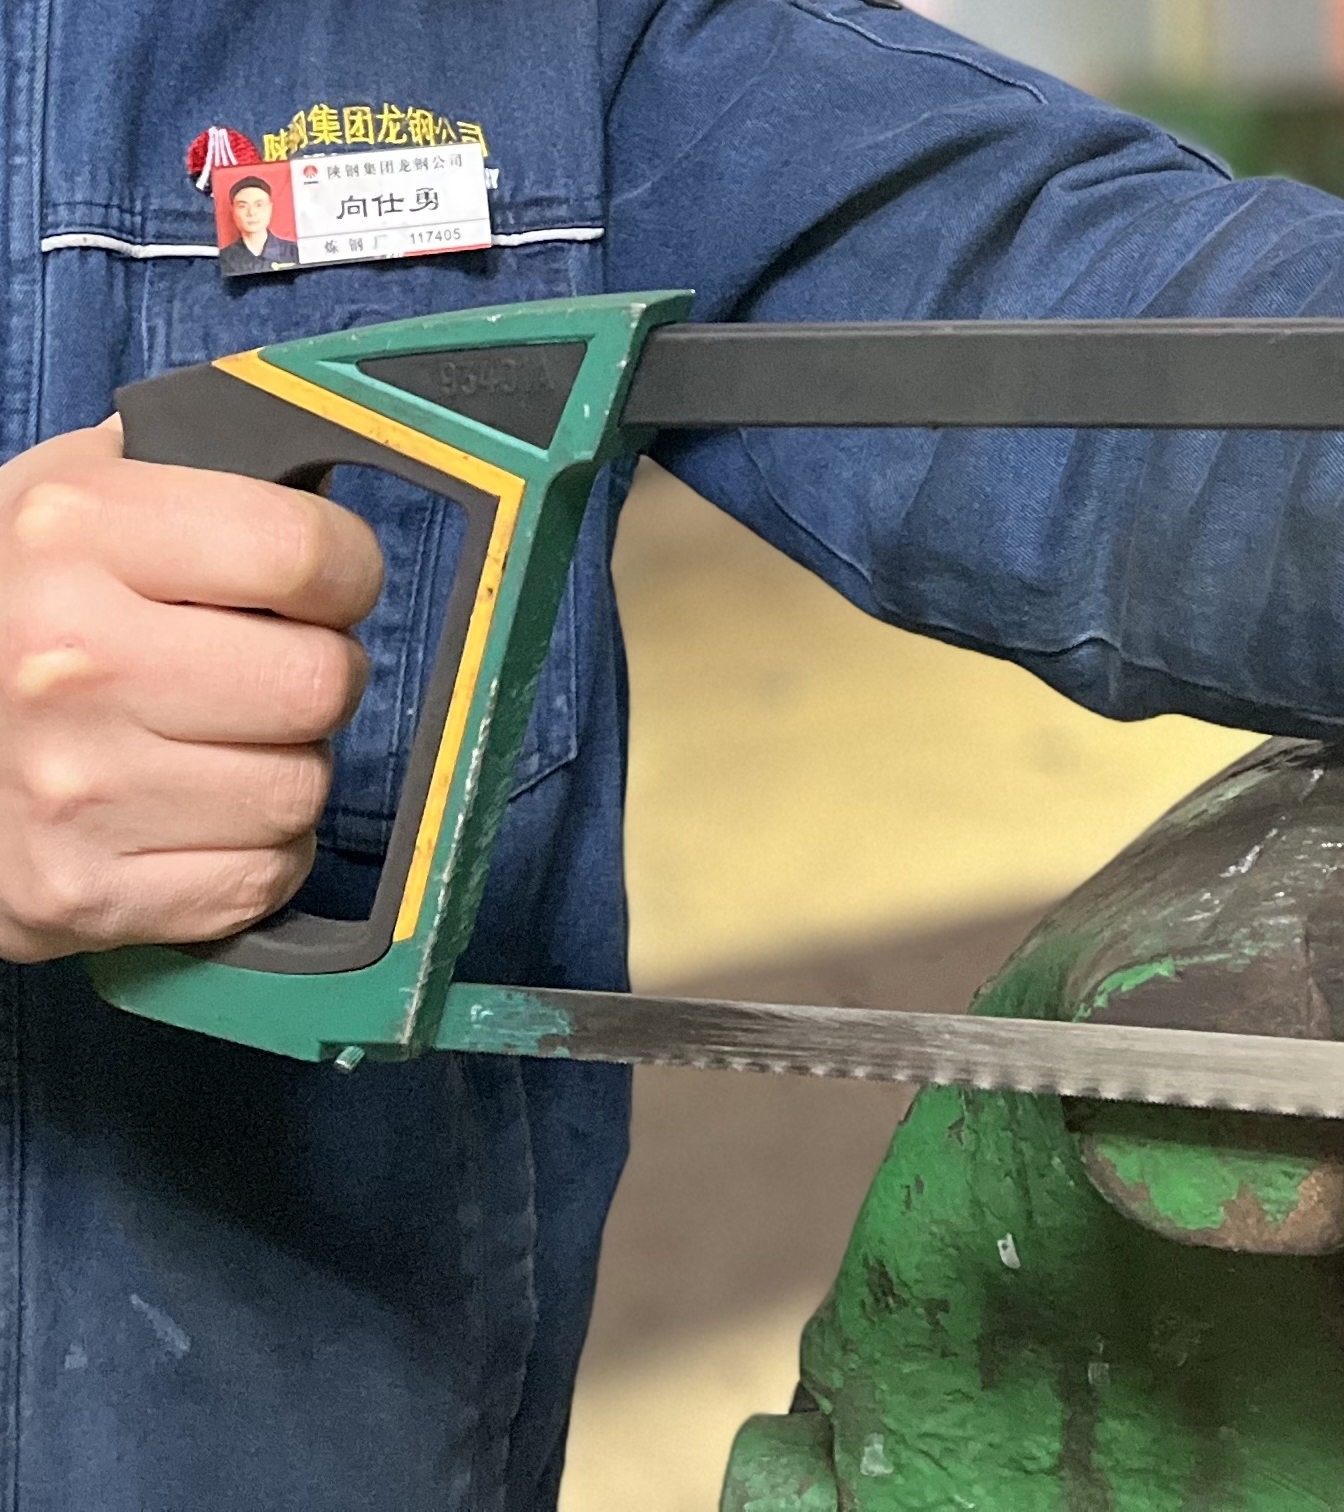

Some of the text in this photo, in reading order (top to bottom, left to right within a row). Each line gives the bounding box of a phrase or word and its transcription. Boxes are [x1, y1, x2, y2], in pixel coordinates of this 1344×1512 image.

[327, 153, 463, 180] 陕钢集团龙钢公司
[336, 187, 440, 220] 向仕勇
[410, 227, 462, 245] 117405
